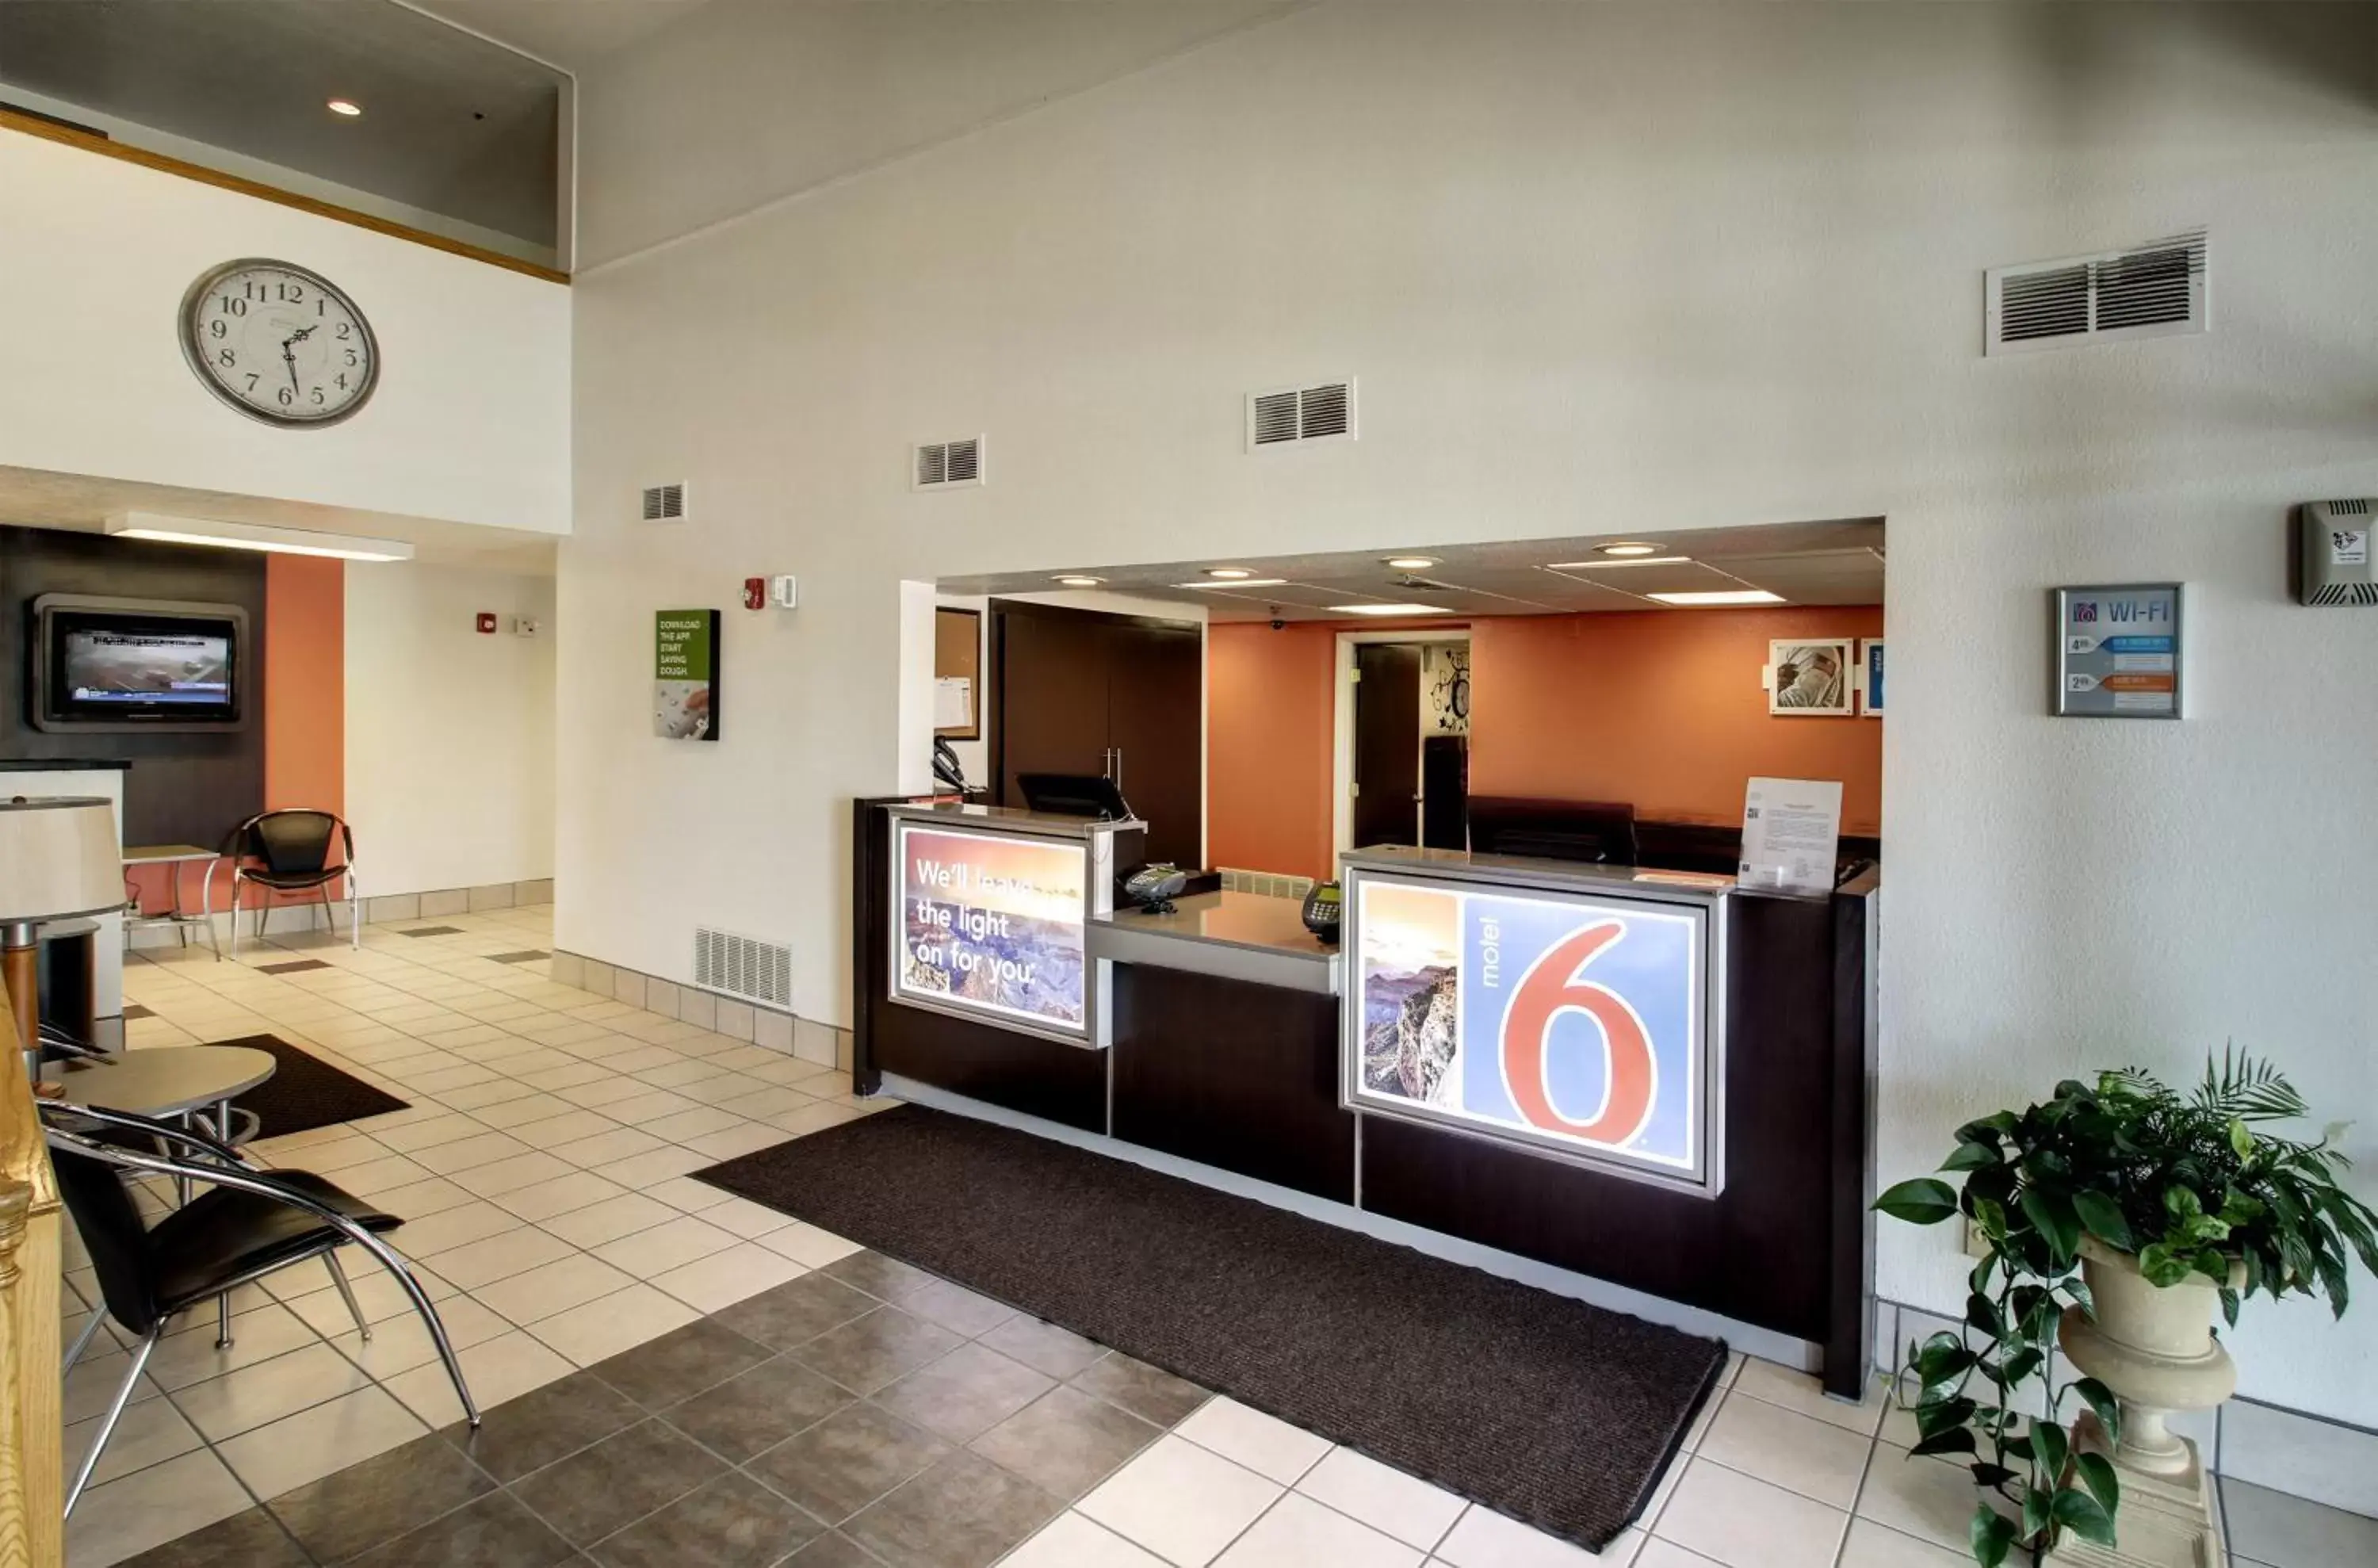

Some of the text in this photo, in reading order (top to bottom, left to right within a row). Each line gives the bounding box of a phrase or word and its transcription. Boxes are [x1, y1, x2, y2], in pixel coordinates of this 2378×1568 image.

[243, 281, 266, 302] 11
[278, 283, 303, 304] 12
[222, 296, 247, 317] 10
[212, 319, 227, 339] 9
[336, 323, 350, 340] 2
[220, 349, 235, 368] 8
[246, 373, 260, 392] 7
[334, 373, 347, 390] 4
[278, 388, 292, 405] 6
[311, 387, 324, 405] 5
[660, 621, 702, 629] DOWNLOAD
[660, 632, 675, 641] THE
[660, 643, 682, 652] START
[660, 655, 687, 664] SAVING
[916, 859, 967, 889] We'll
[917, 898, 1009, 941] the light
[917, 943, 942, 965] on
[951, 941, 981, 972] for
[1478, 917, 1657, 1147] motel 6
